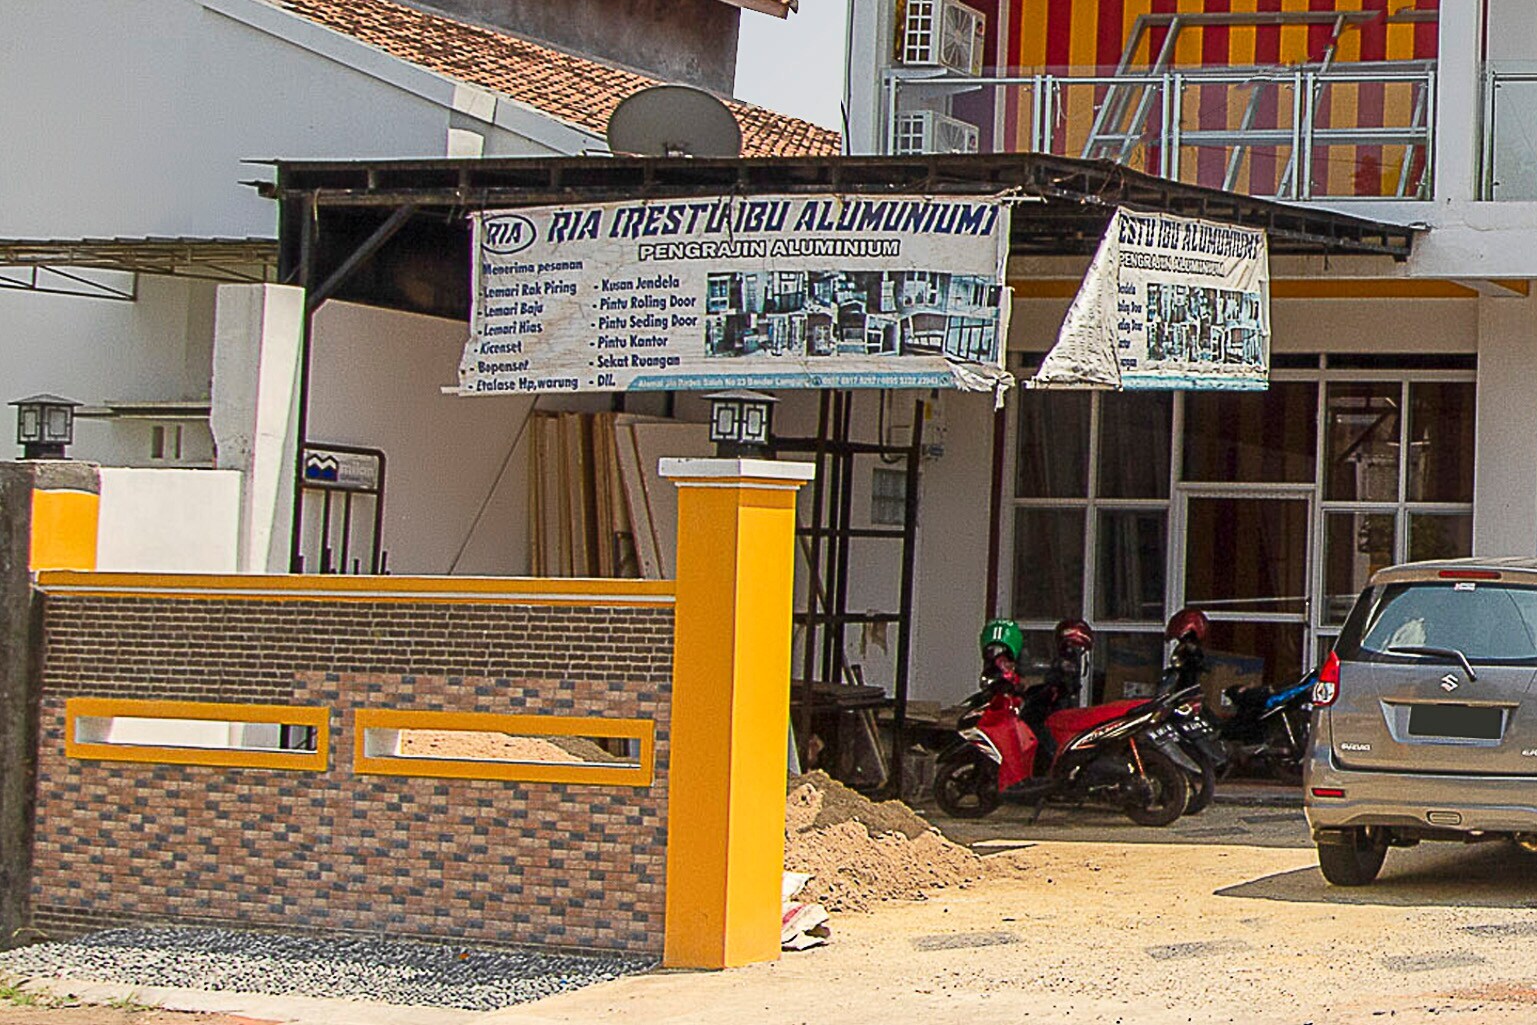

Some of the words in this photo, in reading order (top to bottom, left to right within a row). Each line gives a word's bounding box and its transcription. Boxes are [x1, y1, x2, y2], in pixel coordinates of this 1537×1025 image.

[547, 209, 603, 243] RIA
[733, 201, 791, 233] IBU
[486, 222, 522, 245] RIA
[1157, 219, 1181, 250] IBU
[639, 240, 767, 261] PENGRAJIN
[771, 239, 901, 259] ALUMINIUM
[482, 261, 536, 276] Menerima
[537, 261, 584, 274] pesanan
[484, 283, 520, 298] Lemari
[522, 282, 542, 296] Rak
[544, 279, 577, 295] Piring
[635, 274, 680, 290] Jendela
[484, 302, 518, 317] Lemari
[520, 301, 544, 316] Baju
[600, 296, 629, 310] Pintu
[630, 294, 667, 311] Roling
[669, 295, 697, 308] Door
[484, 321, 517, 336] Lemari
[519, 319, 543, 334] Hias
[598, 316, 627, 329] Pintu
[629, 313, 669, 330] Seding
[671, 313, 698, 327] Door
[598, 335, 627, 349] Pintu
[629, 335, 668, 348] Kantor
[597, 354, 629, 368] Sekat
[631, 354, 681, 369] Ruangan
